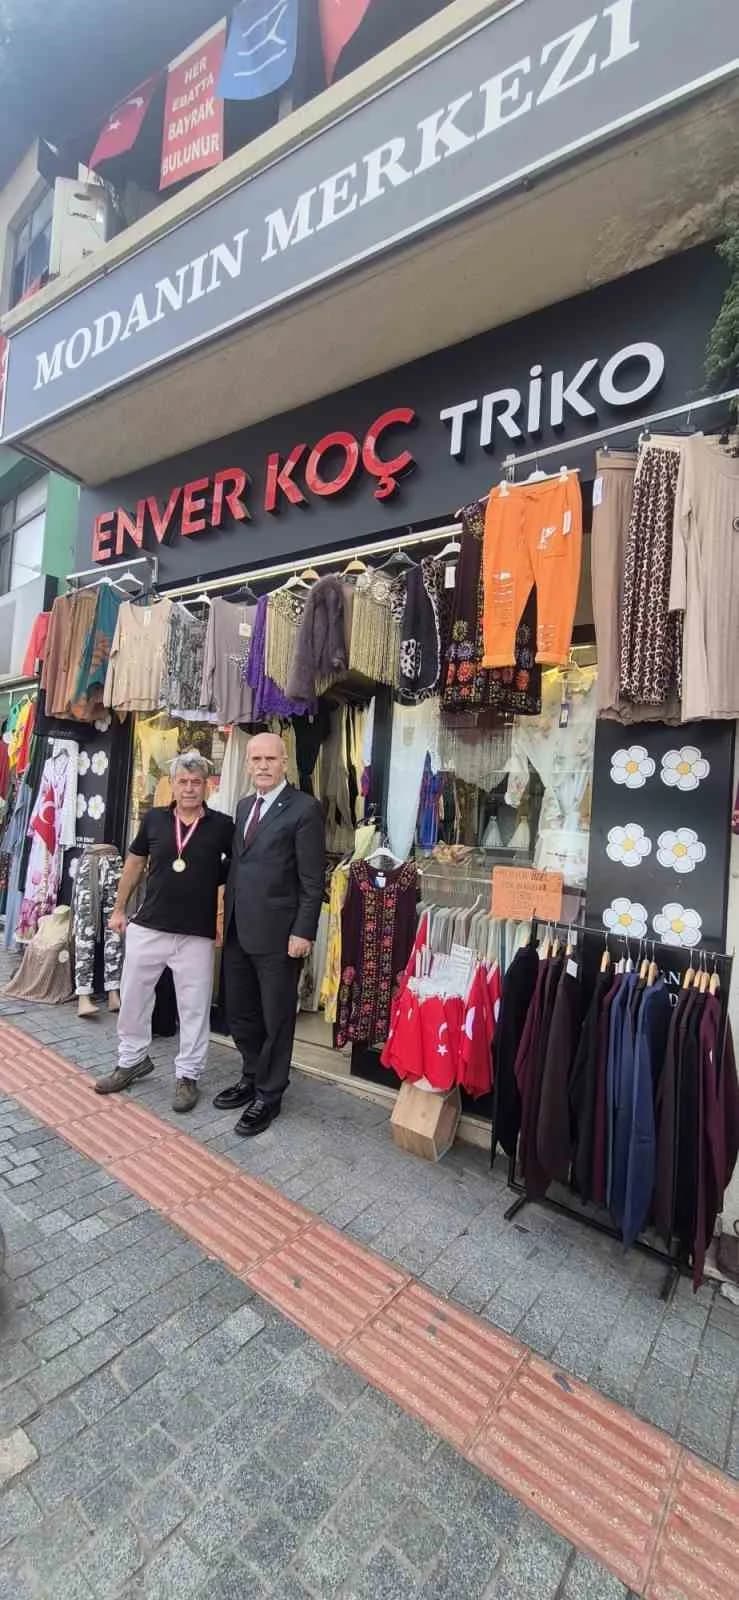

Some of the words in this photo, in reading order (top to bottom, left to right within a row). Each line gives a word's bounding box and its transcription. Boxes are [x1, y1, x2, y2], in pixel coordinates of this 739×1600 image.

[172, 71, 214, 113] EBATTA
[184, 55, 208, 85] HER
[168, 97, 215, 141] BAYRAK
[161, 132, 220, 177] BULUNUR
[33, 229, 249, 392] MODANIN
[91, 467, 251, 564] ENVER
[263, 406, 417, 502] KOÇ
[440, 340, 666, 456] TRİKO
